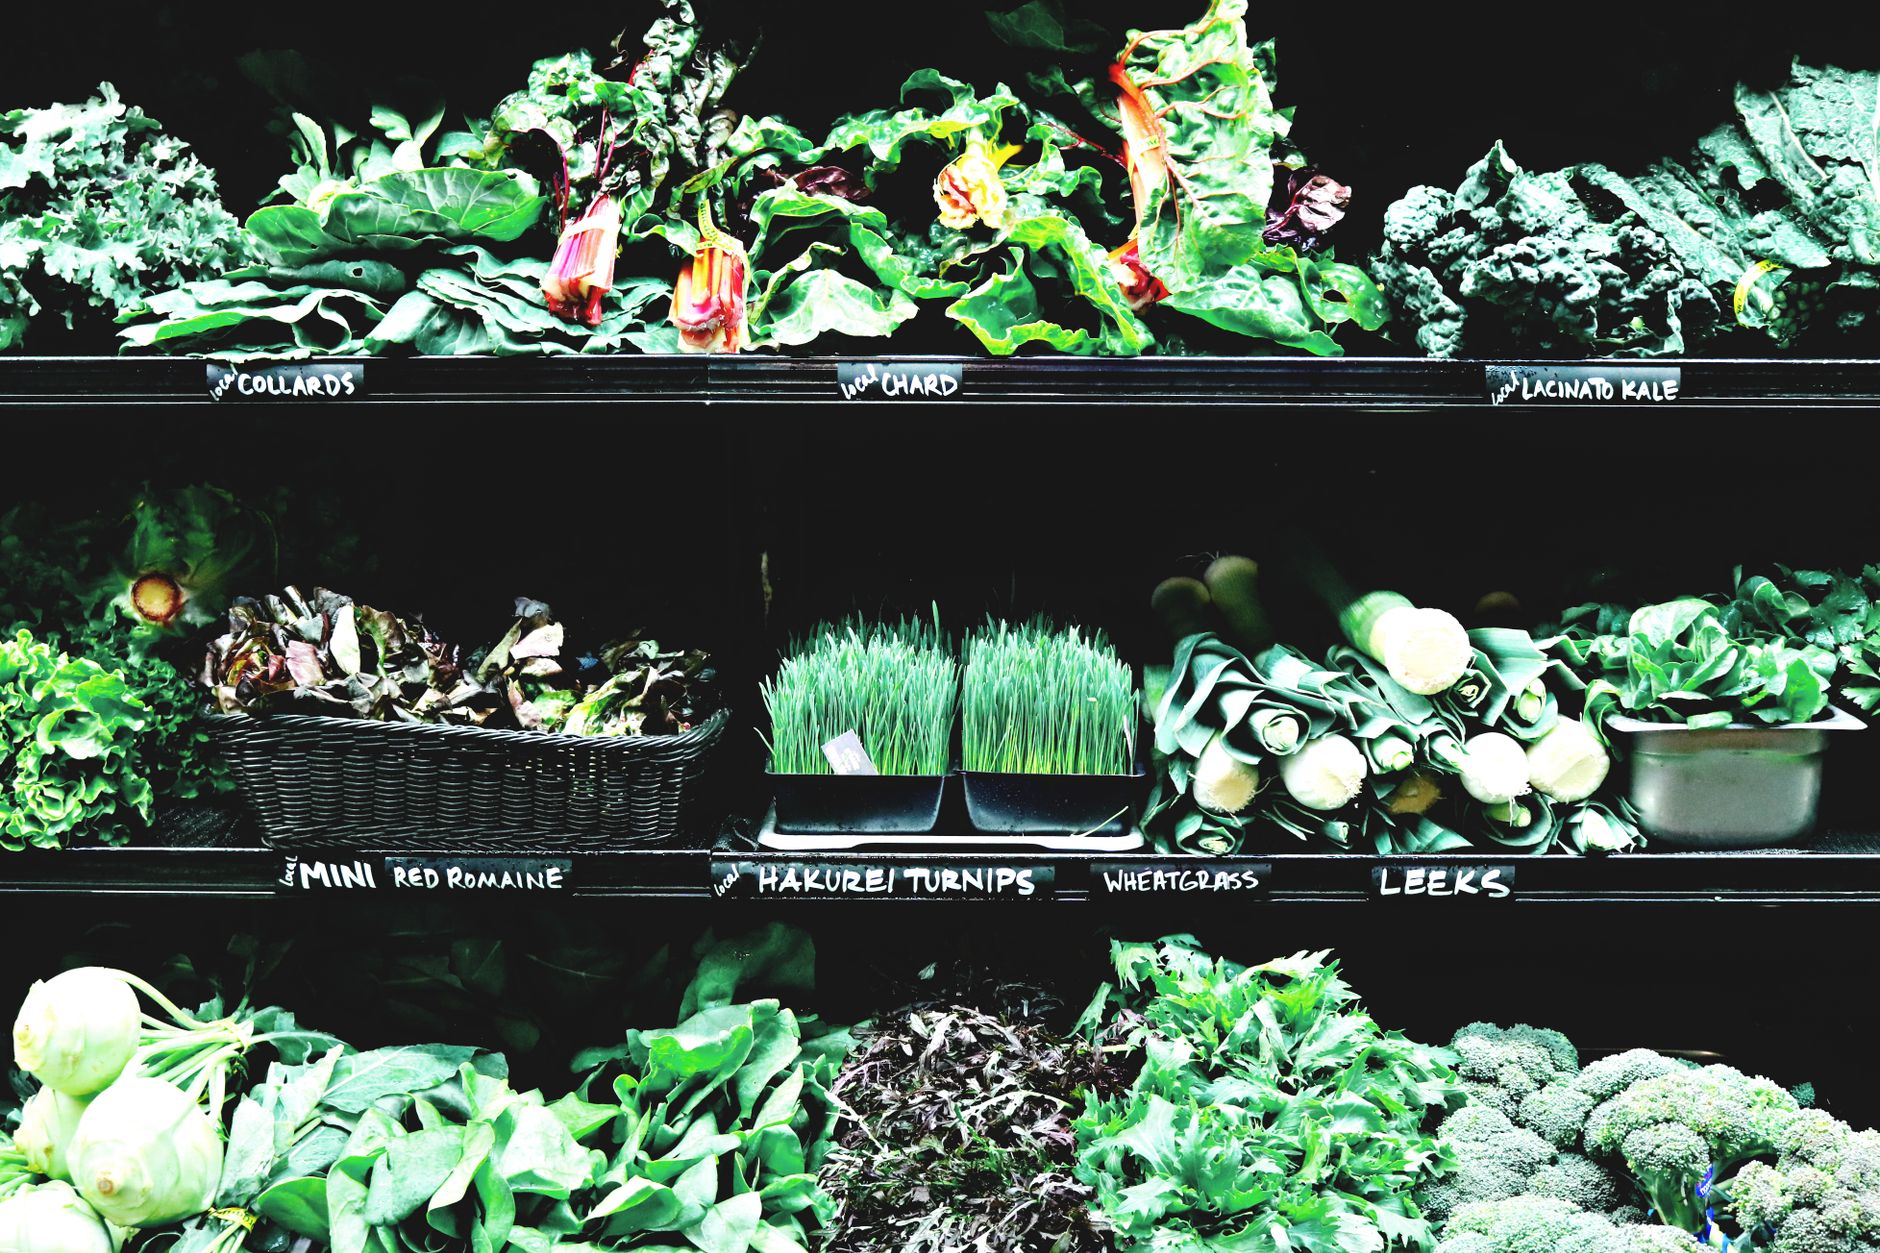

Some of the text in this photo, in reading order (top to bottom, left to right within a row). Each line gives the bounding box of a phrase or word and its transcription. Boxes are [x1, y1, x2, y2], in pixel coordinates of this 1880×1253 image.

[237, 371, 356, 397] COLLARDS
[840, 363, 958, 400] local CHARD
[1491, 370, 1680, 406] local LACINATO KALE
[300, 860, 376, 889] MINI
[393, 866, 440, 888] RED
[446, 866, 564, 889] ROMAINE
[713, 864, 1036, 897] local HAKUREI TURNIPS
[1103, 869, 1260, 893] WHEATGRASS
[1379, 867, 1511, 899] LEEKS
